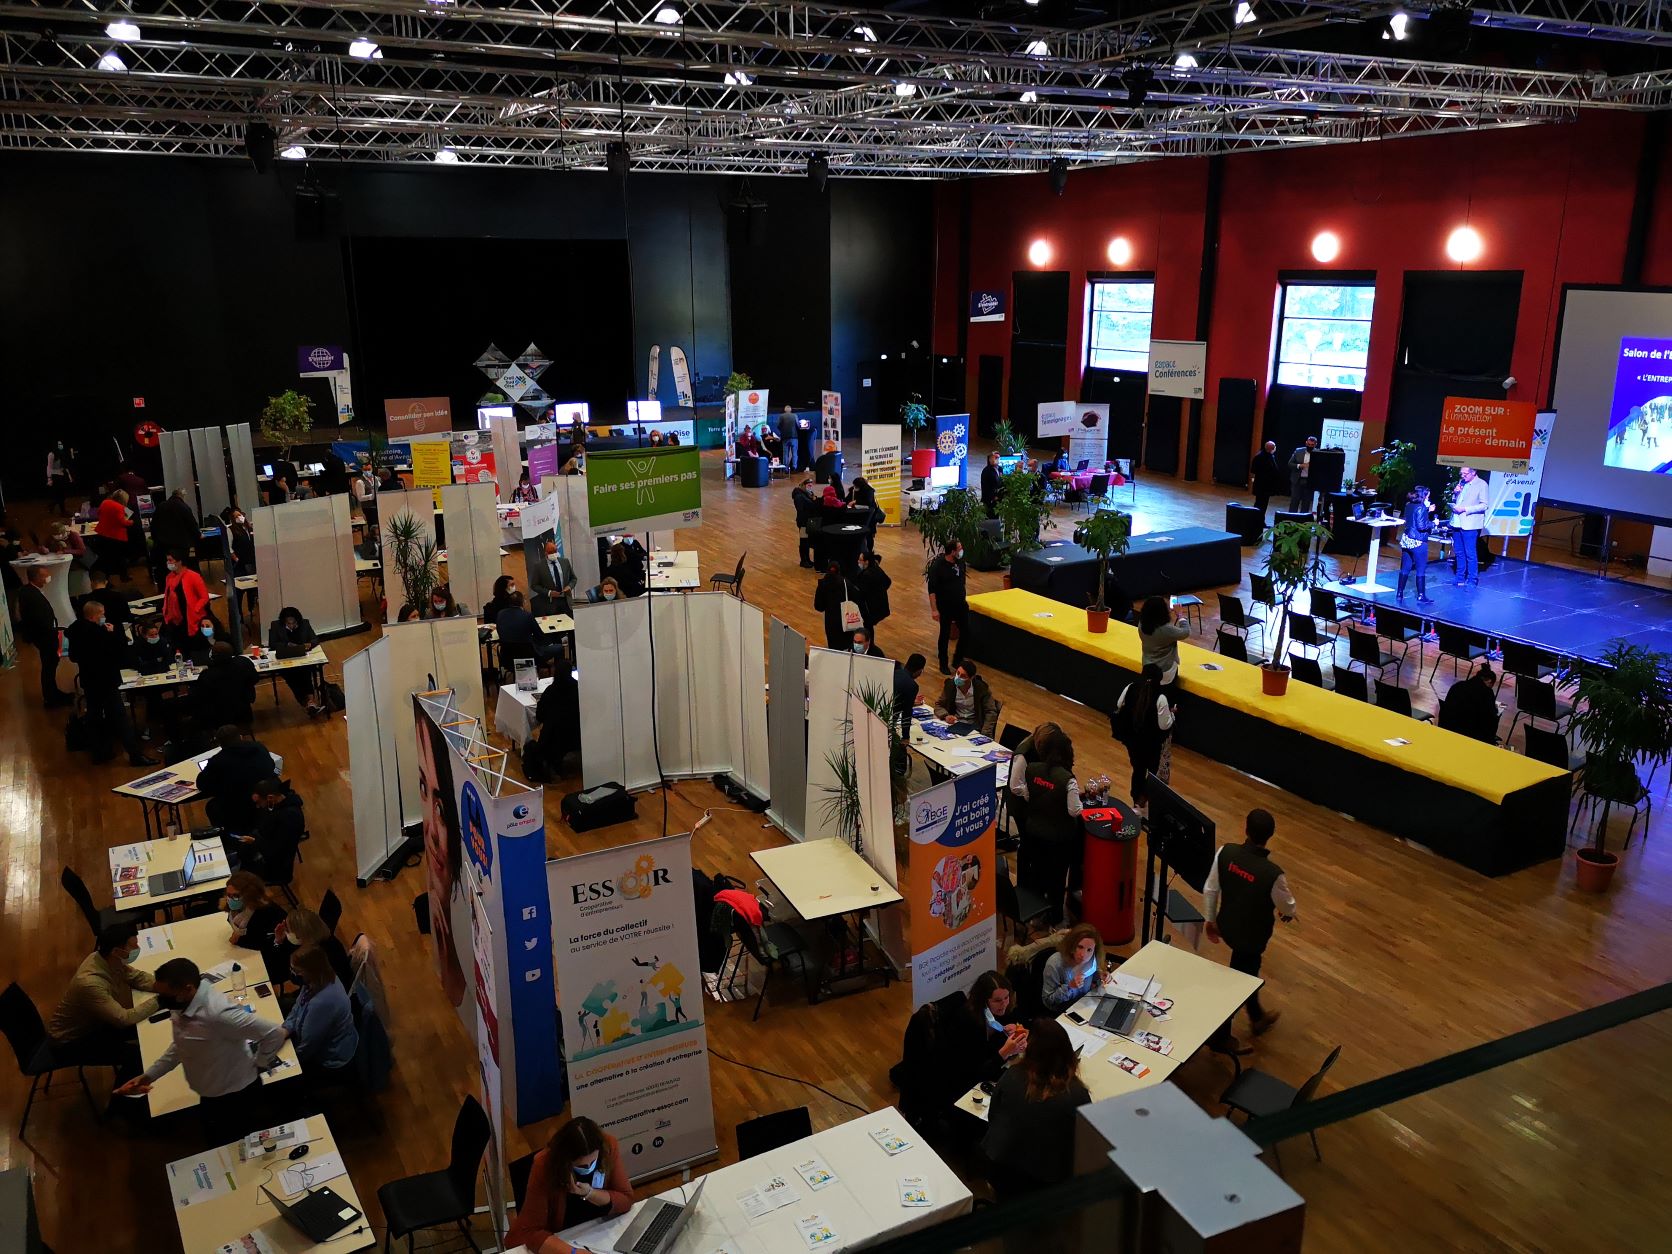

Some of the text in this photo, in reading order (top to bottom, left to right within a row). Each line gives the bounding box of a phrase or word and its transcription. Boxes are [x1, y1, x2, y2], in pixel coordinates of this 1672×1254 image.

[1623, 347, 1648, 358] Salon
[1650, 349, 1662, 359] de
[1154, 369, 1197, 378] Conférences
[1454, 404, 1483, 413] ZOOM
[1485, 406, 1505, 415] SUR
[1443, 424, 1497, 437] Le présent
[1484, 434, 1526, 448] demain
[593, 471, 697, 495] Faire ses premiers pas
[1505, 478, 1536, 486] d'Avenir
[955, 793, 990, 816] J'ai créé
[930, 805, 948, 821] BGE
[955, 817, 968, 827] ma
[970, 806, 990, 821] boîte
[506, 821, 519, 830] pôle
[955, 815, 990, 838] et vous ?
[579, 899, 613, 912] Coopérative
[580, 903, 623, 918] d'entrepreneurs
[569, 919, 649, 944] La force du collectif
[570, 945, 581, 954] au
[581, 939, 608, 951] service
[608, 935, 619, 944] de
[619, 930, 643, 941] VOTRE
[643, 924, 671, 936] réussite
[575, 1082, 589, 1091] une
[590, 1072, 624, 1087] alternative
[630, 1065, 638, 1074] la
[638, 1059, 665, 1072] création
[665, 1049, 703, 1064] d'entreprise
